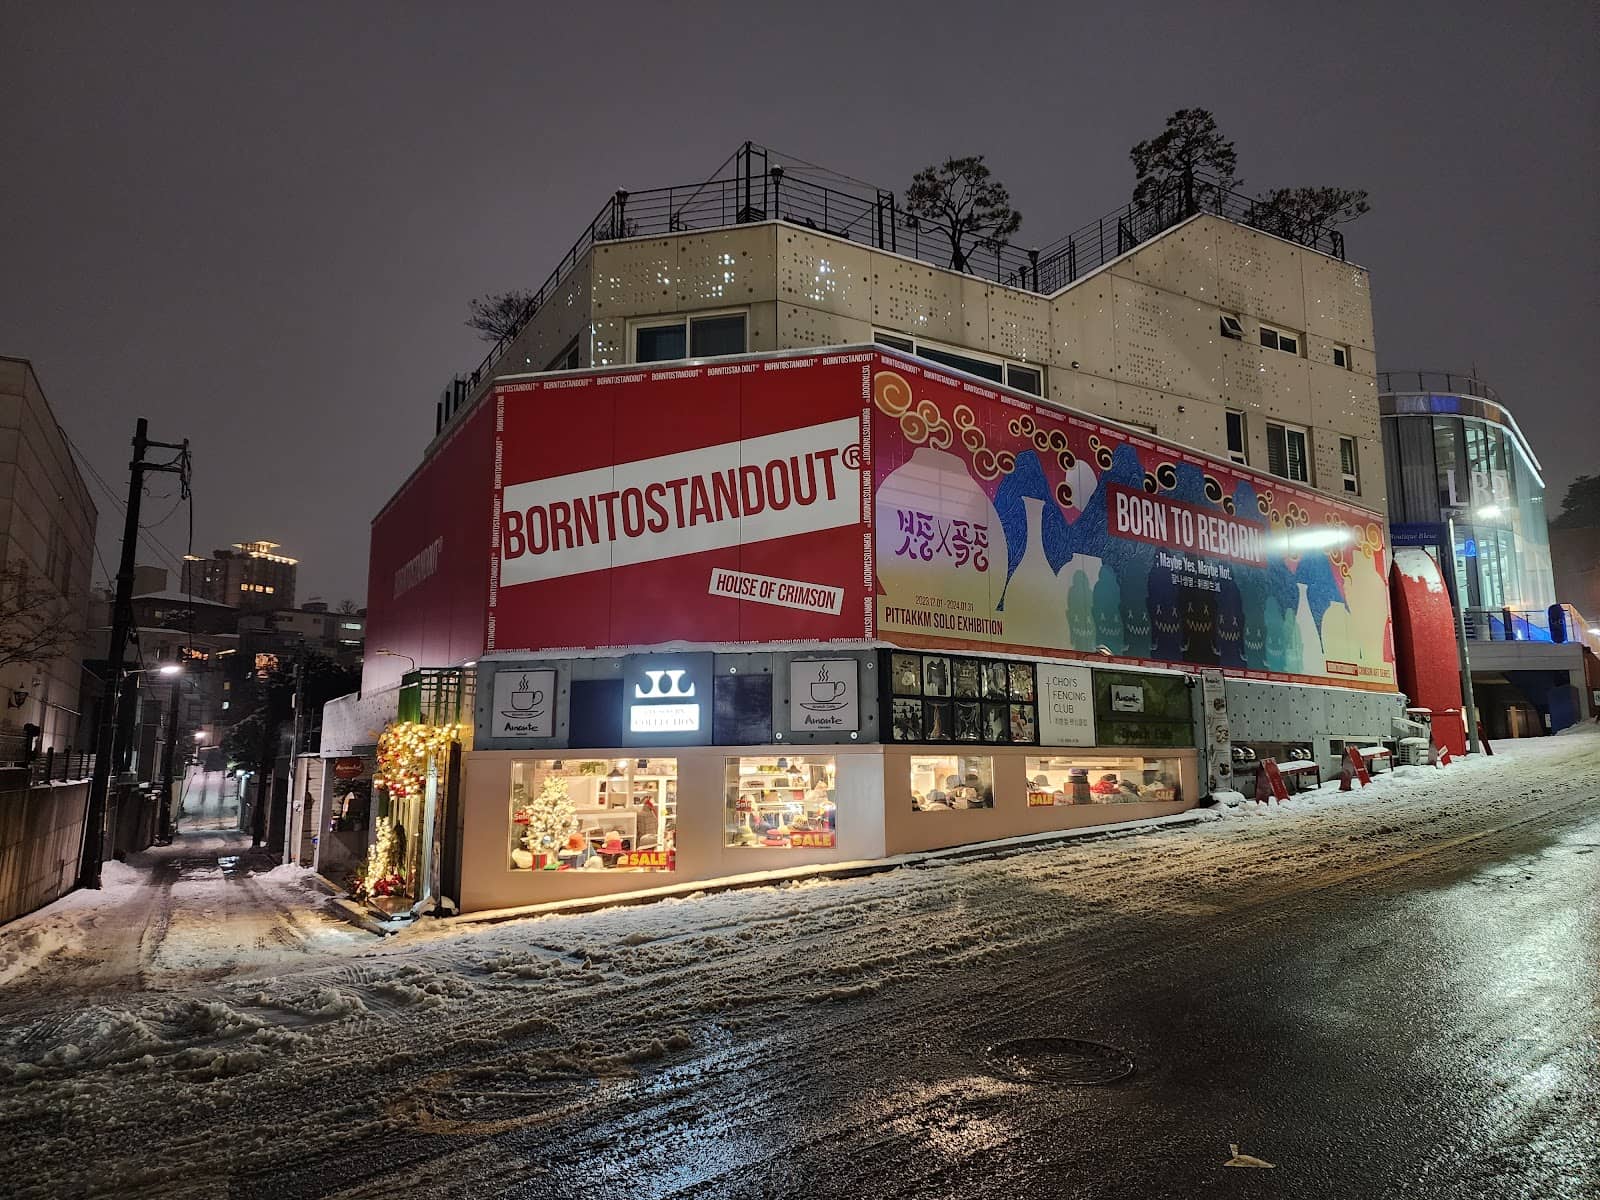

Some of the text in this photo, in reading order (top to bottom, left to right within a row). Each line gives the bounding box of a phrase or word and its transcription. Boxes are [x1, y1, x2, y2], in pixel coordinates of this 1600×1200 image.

[1116, 492, 1168, 542] BORN
[1171, 506, 1194, 547] TO
[1160, 552, 1182, 571] Maybe
[1198, 560, 1218, 578] Maybe
[717, 574, 836, 609] HOUSE OF CRIMSON
[886, 606, 1002, 636] PITTAKKM SOLO EXHIBITION
[1053, 690, 1086, 702] FENCING
[1054, 704, 1074, 714] CLUB
[1030, 794, 1053, 805] SALE
[792, 834, 832, 846] SALE
[630, 853, 666, 865] SALE
